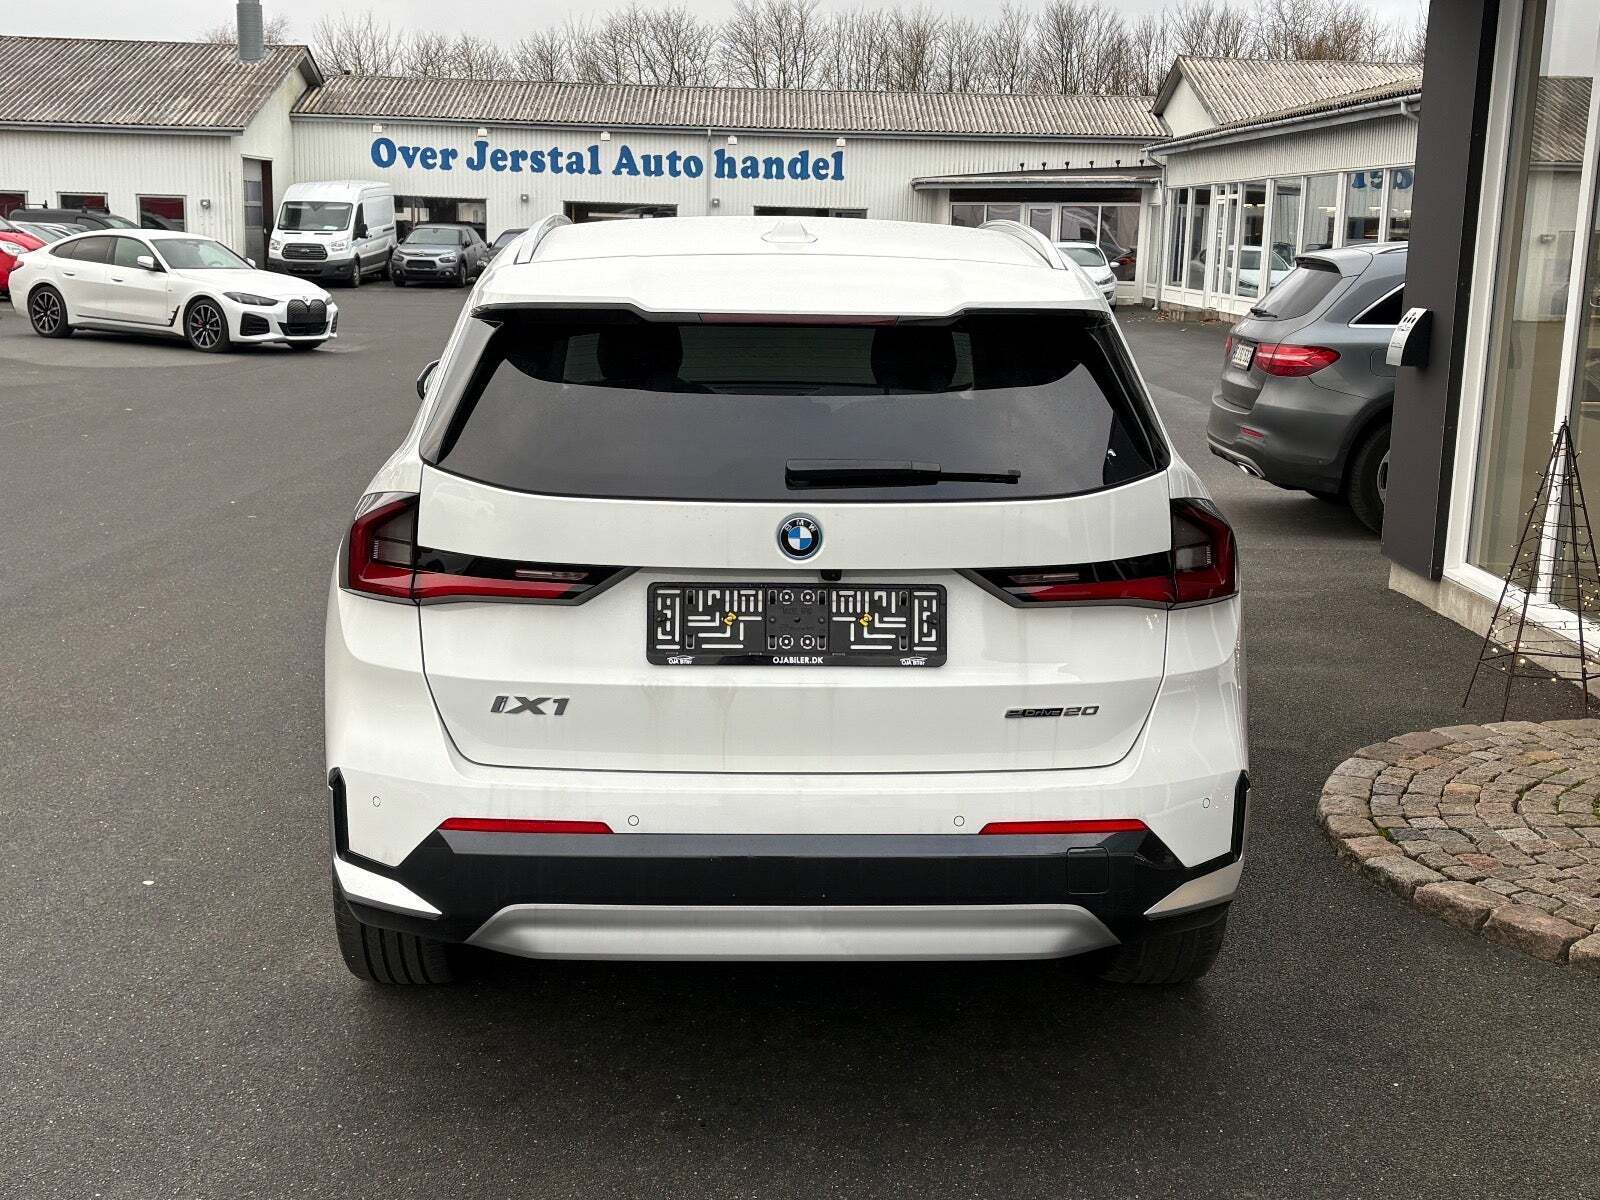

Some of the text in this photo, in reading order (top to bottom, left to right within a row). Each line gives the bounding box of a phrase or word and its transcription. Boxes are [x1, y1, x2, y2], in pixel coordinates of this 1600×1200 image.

[371, 137, 845, 181] Over Jerstal Auto handel
[490, 695, 570, 716] iX1
